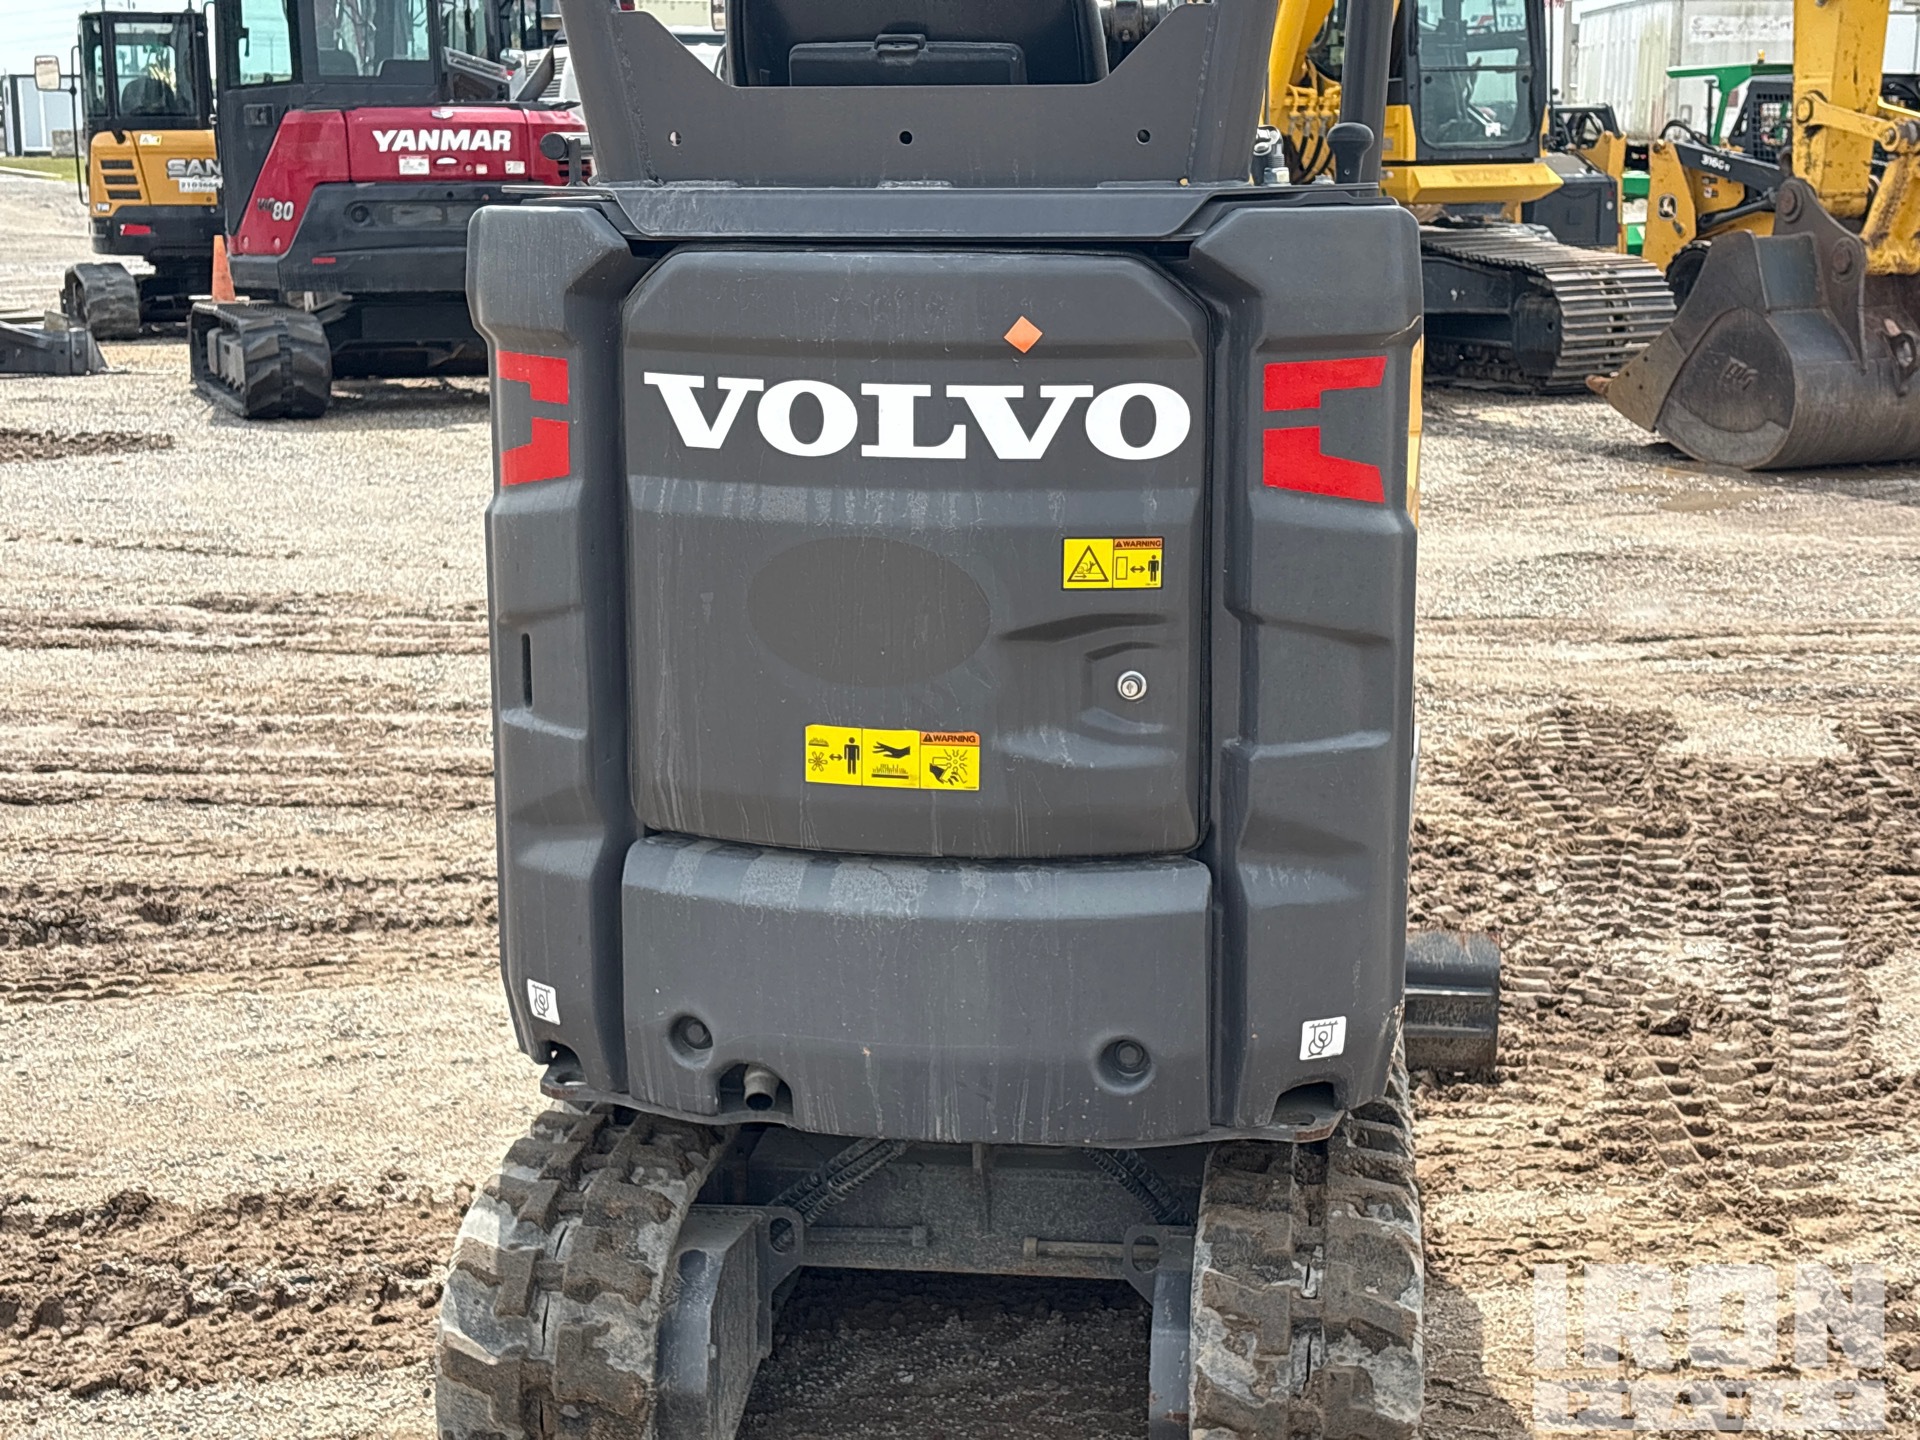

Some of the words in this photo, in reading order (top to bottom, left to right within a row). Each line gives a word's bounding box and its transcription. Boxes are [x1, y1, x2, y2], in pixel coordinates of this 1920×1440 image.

[372, 129, 512, 153] YANMAR
[643, 371, 1191, 461] VOLVO
[1123, 540, 1162, 548] WARNING
[932, 734, 976, 744] WARNING
